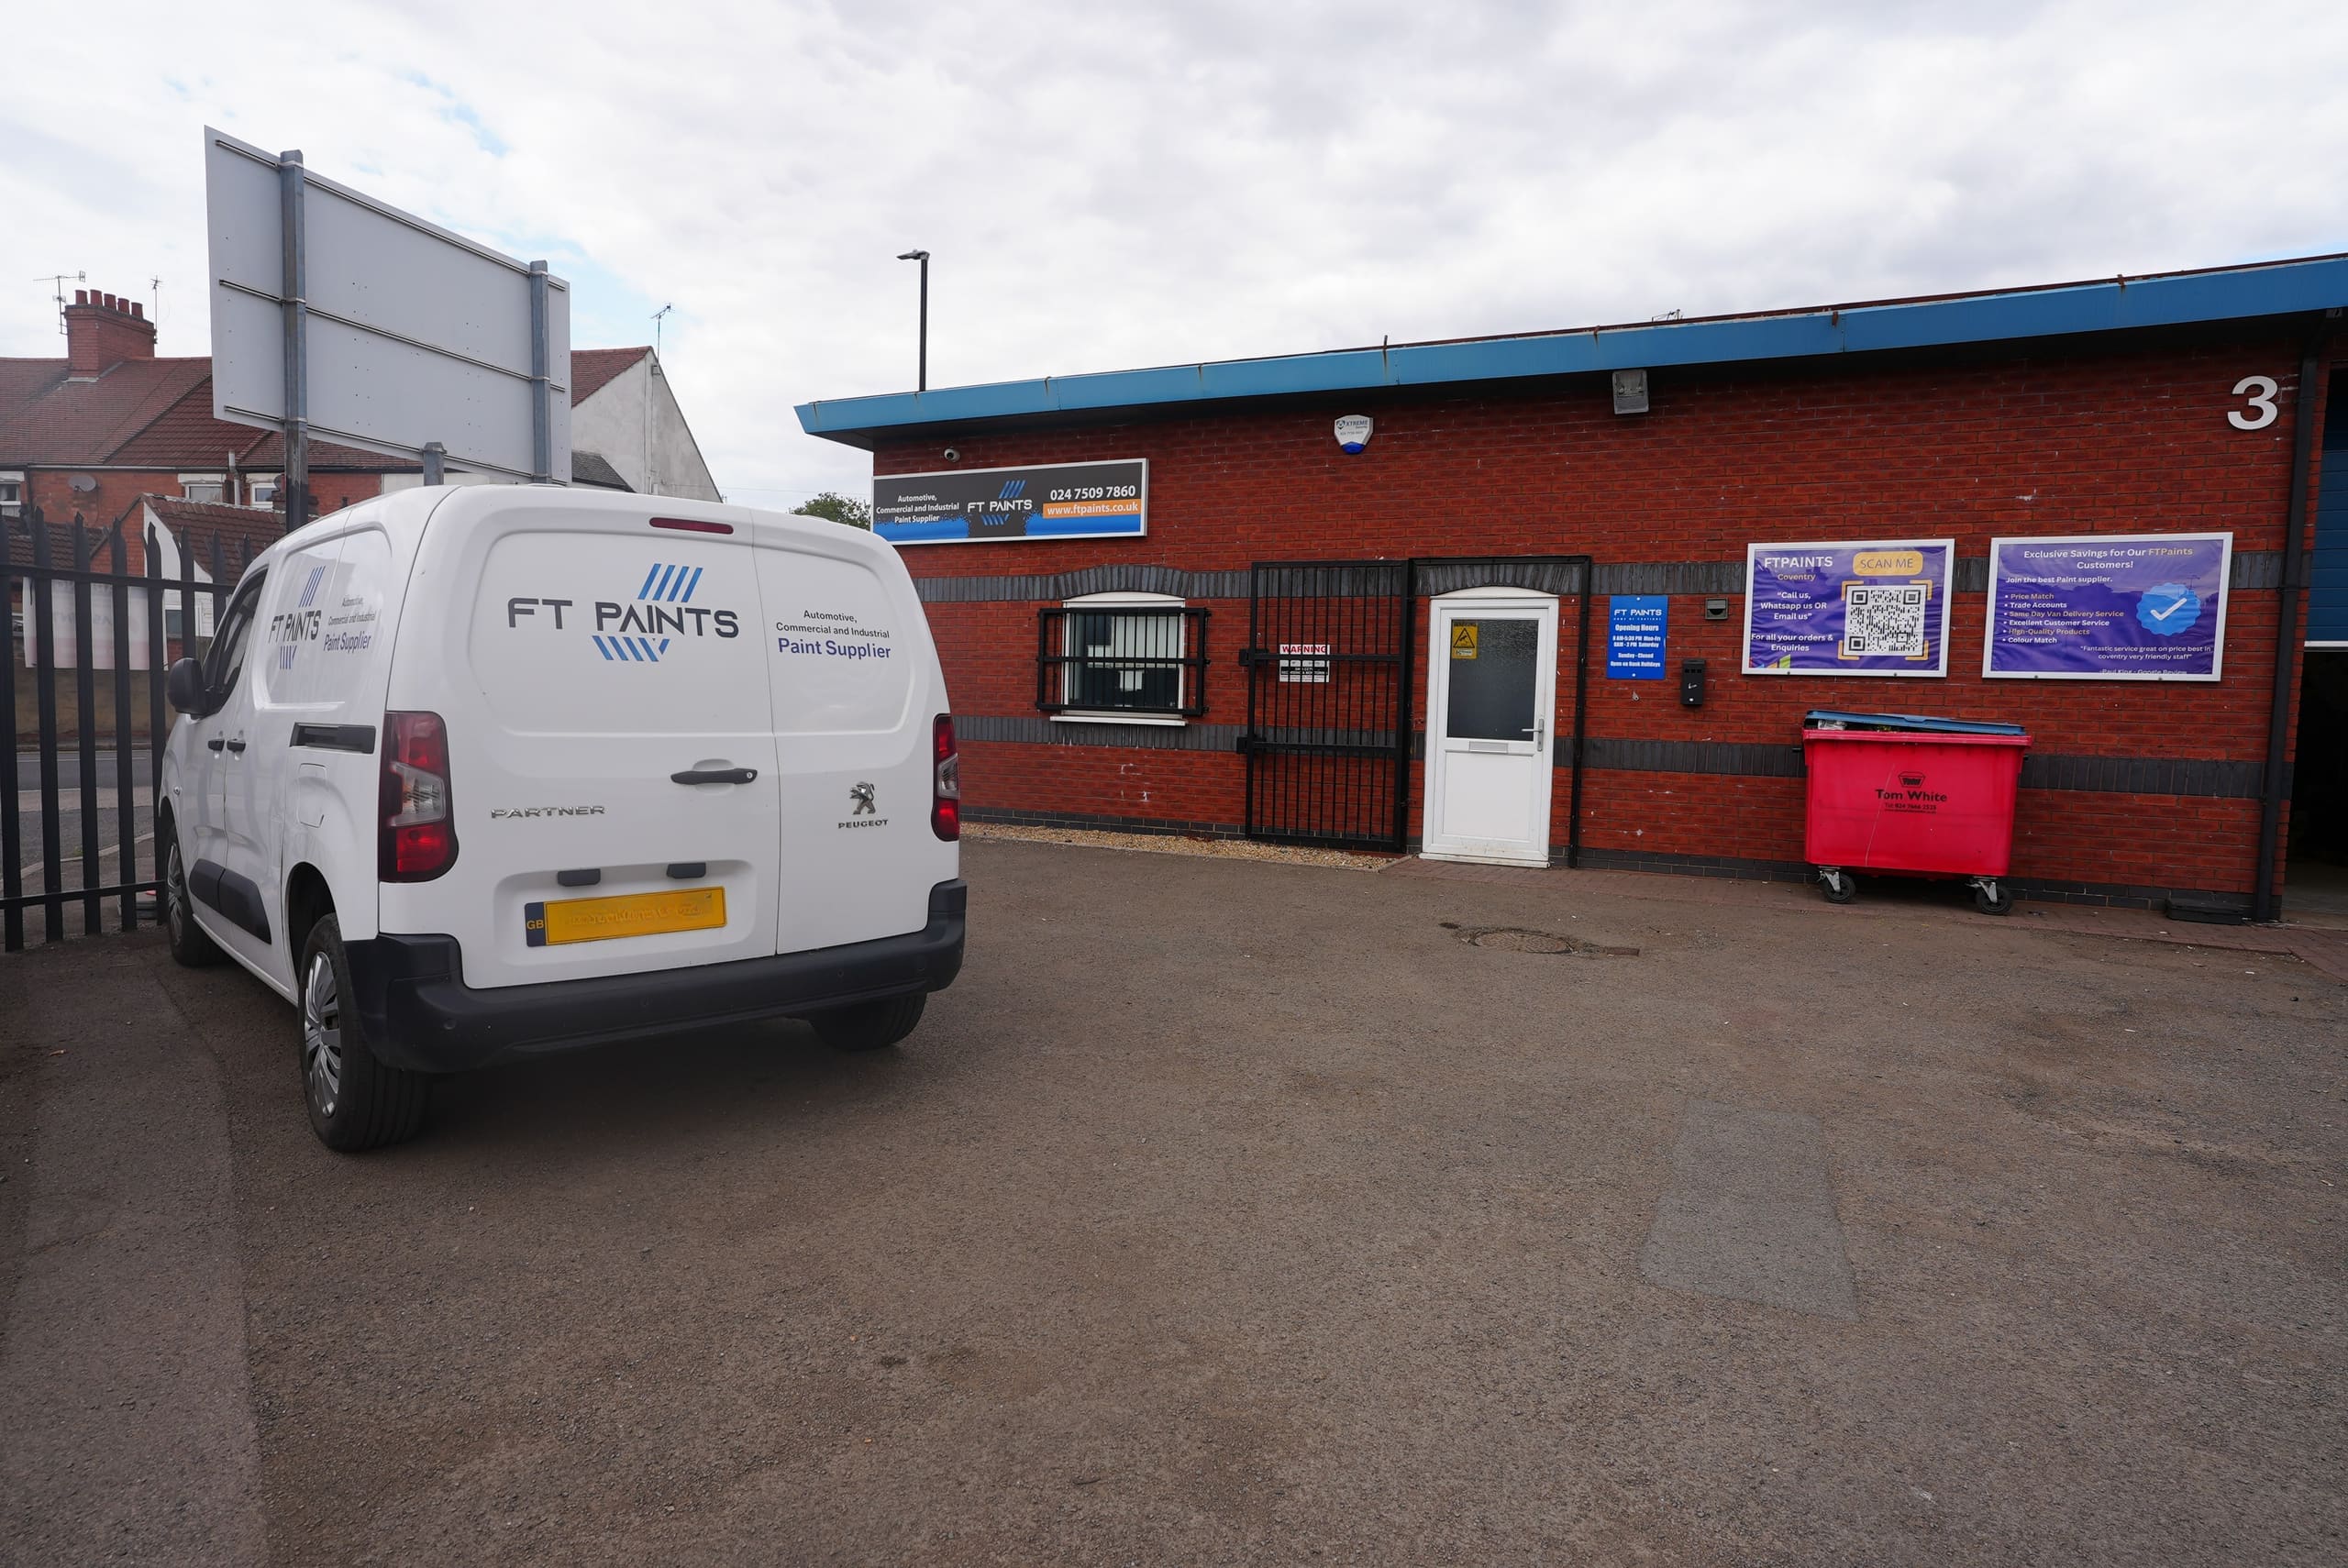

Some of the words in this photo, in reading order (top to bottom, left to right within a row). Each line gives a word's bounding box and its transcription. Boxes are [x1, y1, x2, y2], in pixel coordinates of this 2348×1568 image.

[2227, 375, 2278, 430] 3
[897, 493, 937, 502] Automotive,
[1050, 489, 1072, 501] 024
[1074, 487, 1103, 500] 7509
[1106, 485, 1135, 498] 7860
[876, 505, 913, 514] Commercial
[914, 504, 927, 512] and
[928, 502, 959, 511] Industrial
[967, 502, 985, 513] FT
[990, 499, 1033, 512] PAINTS
[1047, 502, 1138, 516] www.ftpaints.co.uk
[912, 514, 940, 524] Supplier
[2070, 550, 2108, 558] Savings
[2110, 549, 2125, 557] for
[2127, 549, 2146, 557] Our
[2148, 547, 2193, 556] FTPaints
[1764, 556, 1833, 569] FTPAINTS
[1860, 558, 1892, 569] SCAN
[1895, 558, 1914, 569] ME
[2077, 561, 2134, 569] Customers!
[1778, 573, 1816, 581] Coventry
[2078, 575, 2113, 584] supplier.
[1760, 602, 1801, 611] Whatsapp
[507, 596, 573, 630] FT
[594, 601, 739, 639] PAINTS
[803, 609, 858, 623] Automotive,
[268, 614, 285, 644] FT
[283, 610, 321, 642] PAINTS
[776, 622, 831, 634] Commercial
[833, 627, 850, 635] and
[851, 627, 890, 638] Industrial
[324, 634, 340, 651] Paint
[340, 630, 371, 653] Supplier
[1778, 634, 1797, 642] your
[778, 637, 822, 654] Paint
[825, 640, 891, 660] Supplier
[1771, 644, 1810, 652] Enquiries
[1875, 789, 1903, 800] Tom
[1907, 791, 1947, 802] White
[491, 805, 606, 819] PARTNER
[838, 819, 889, 829] PEUGEOT
[526, 919, 544, 930] GB
